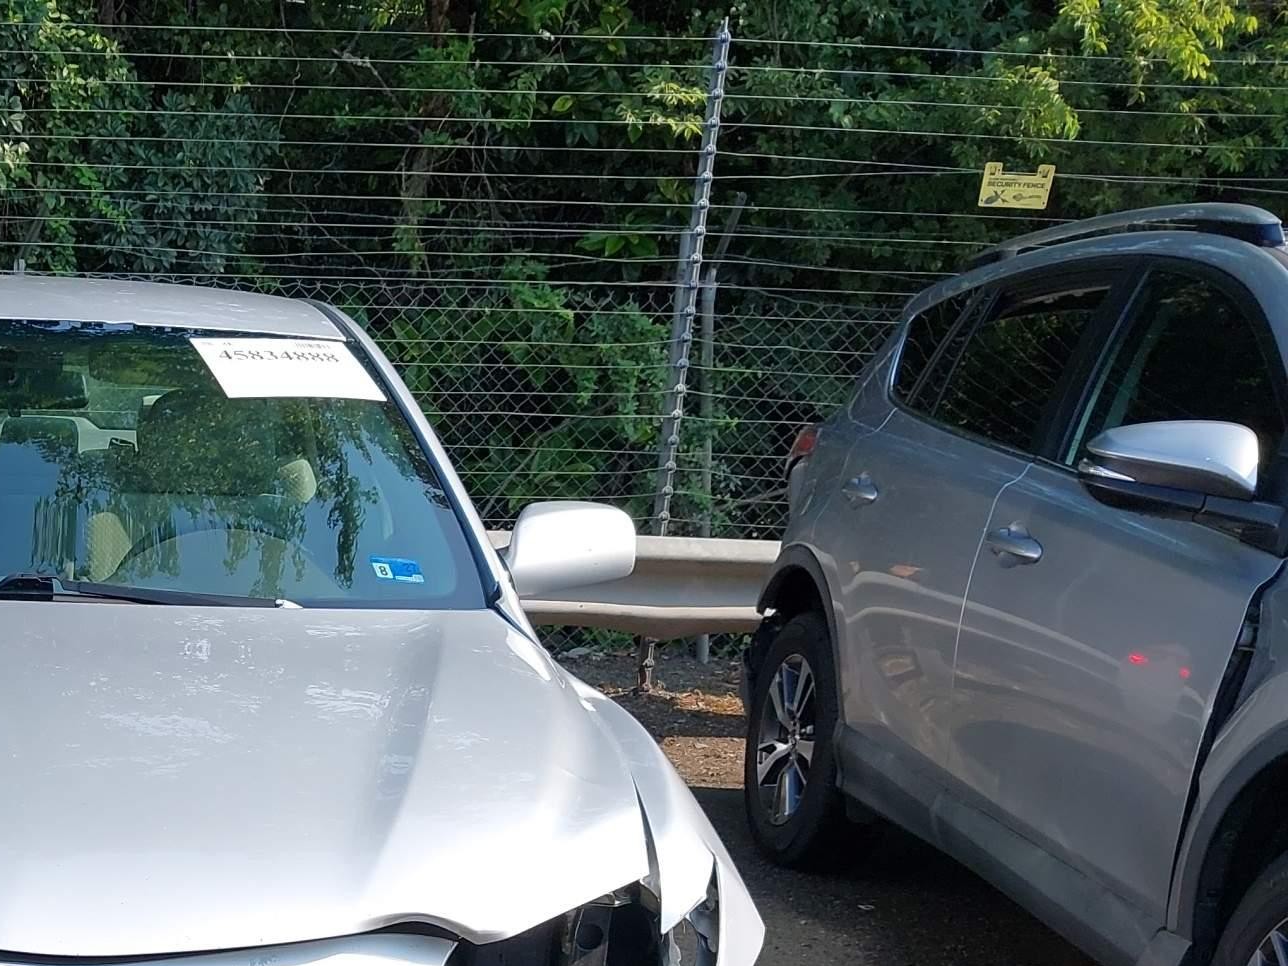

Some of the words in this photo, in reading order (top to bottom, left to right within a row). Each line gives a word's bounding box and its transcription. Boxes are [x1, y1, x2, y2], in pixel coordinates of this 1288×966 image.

[987, 181, 1022, 189] SECURITY
[219, 350, 340, 363] 45834888
[379, 566, 388, 576] 8
